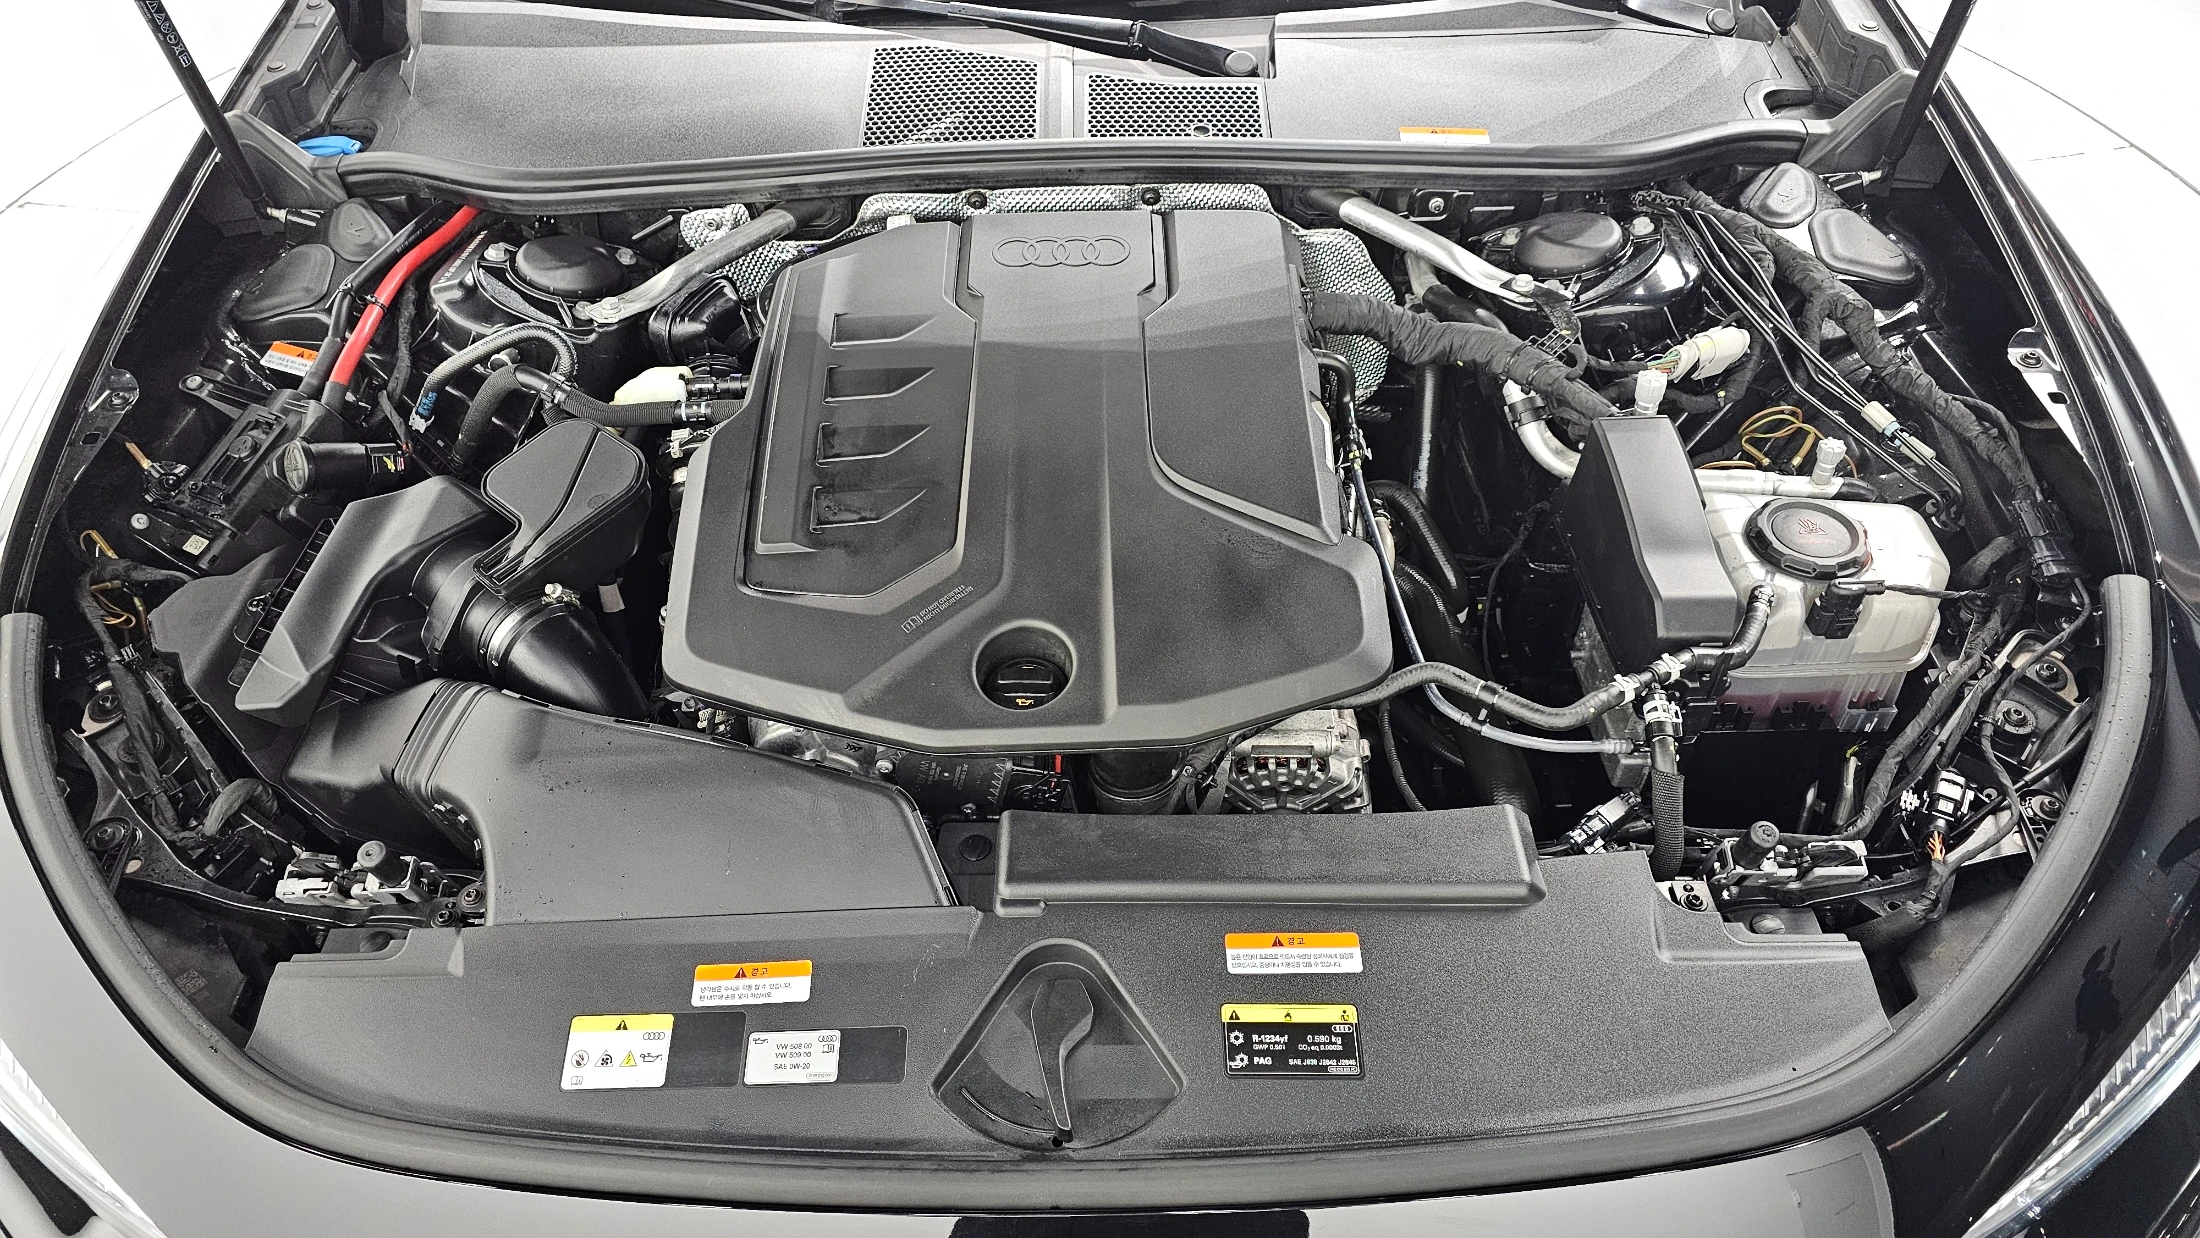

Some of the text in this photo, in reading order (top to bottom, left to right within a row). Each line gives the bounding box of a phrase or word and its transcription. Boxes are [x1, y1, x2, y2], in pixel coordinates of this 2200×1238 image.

[1252, 1034, 1288, 1044] R-1234yf
[1332, 1035, 1342, 1044] kg
[1254, 1056, 1272, 1065] PAG
